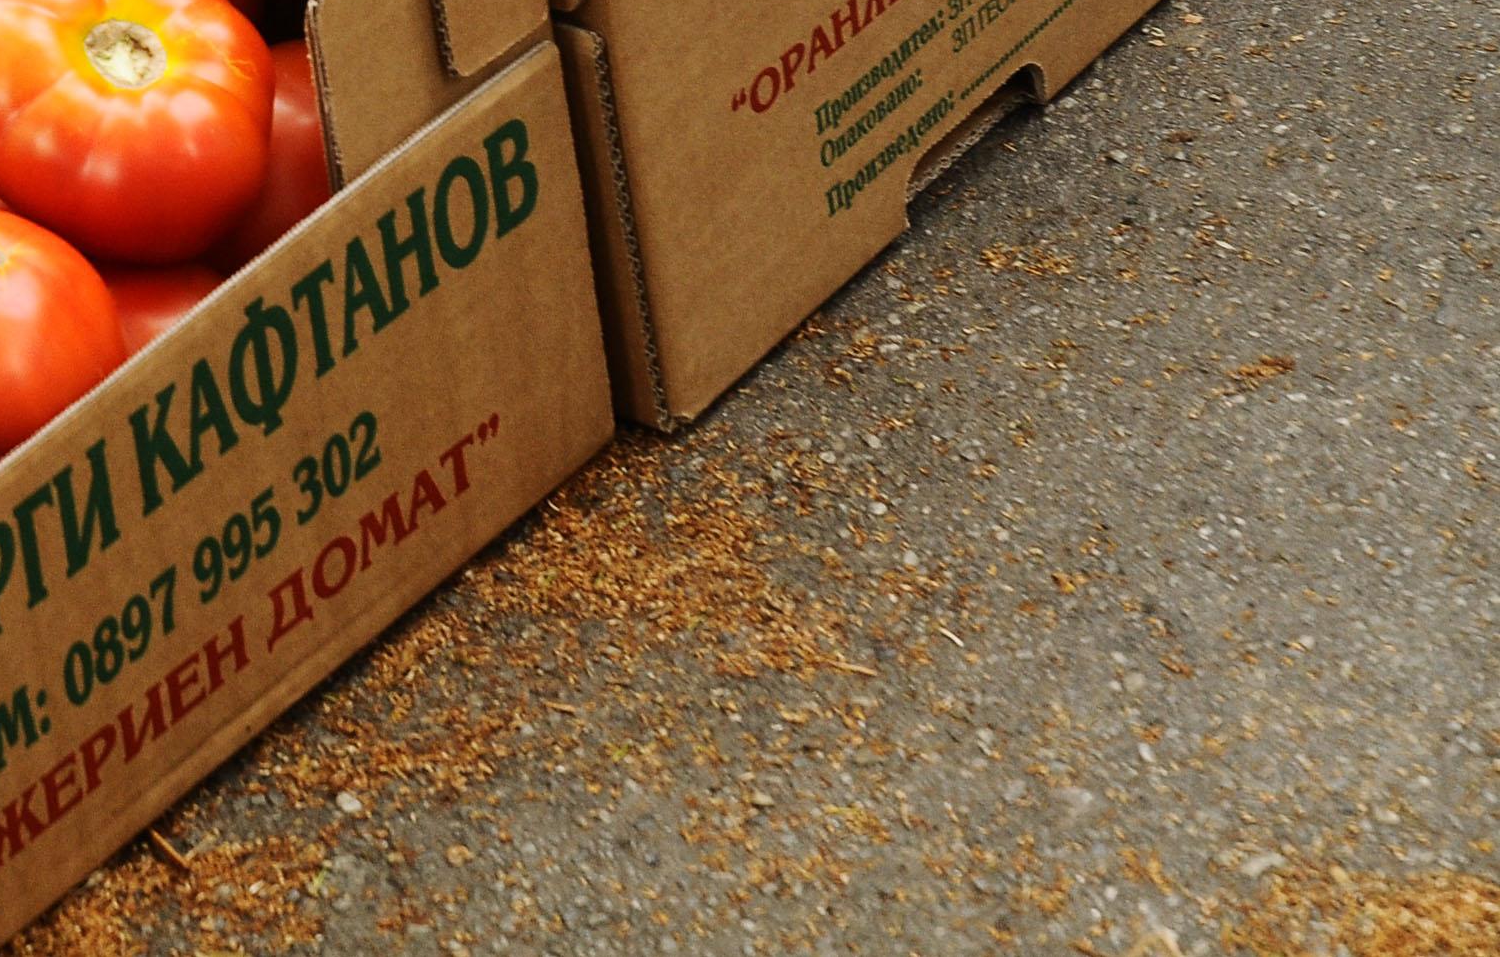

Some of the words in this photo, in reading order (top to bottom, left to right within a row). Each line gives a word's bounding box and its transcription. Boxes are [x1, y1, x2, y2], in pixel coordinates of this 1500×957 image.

[813, 7, 945, 135] Производител:
[820, 68, 924, 168] Опаковано:
[951, 18, 978, 54] ЗП
[824, 89, 955, 217] Произведено:
[128, 118, 541, 519] КАФТАНОВ
[62, 568, 179, 707] 0897
[191, 499, 283, 605] 995
[293, 409, 383, 527] 302
